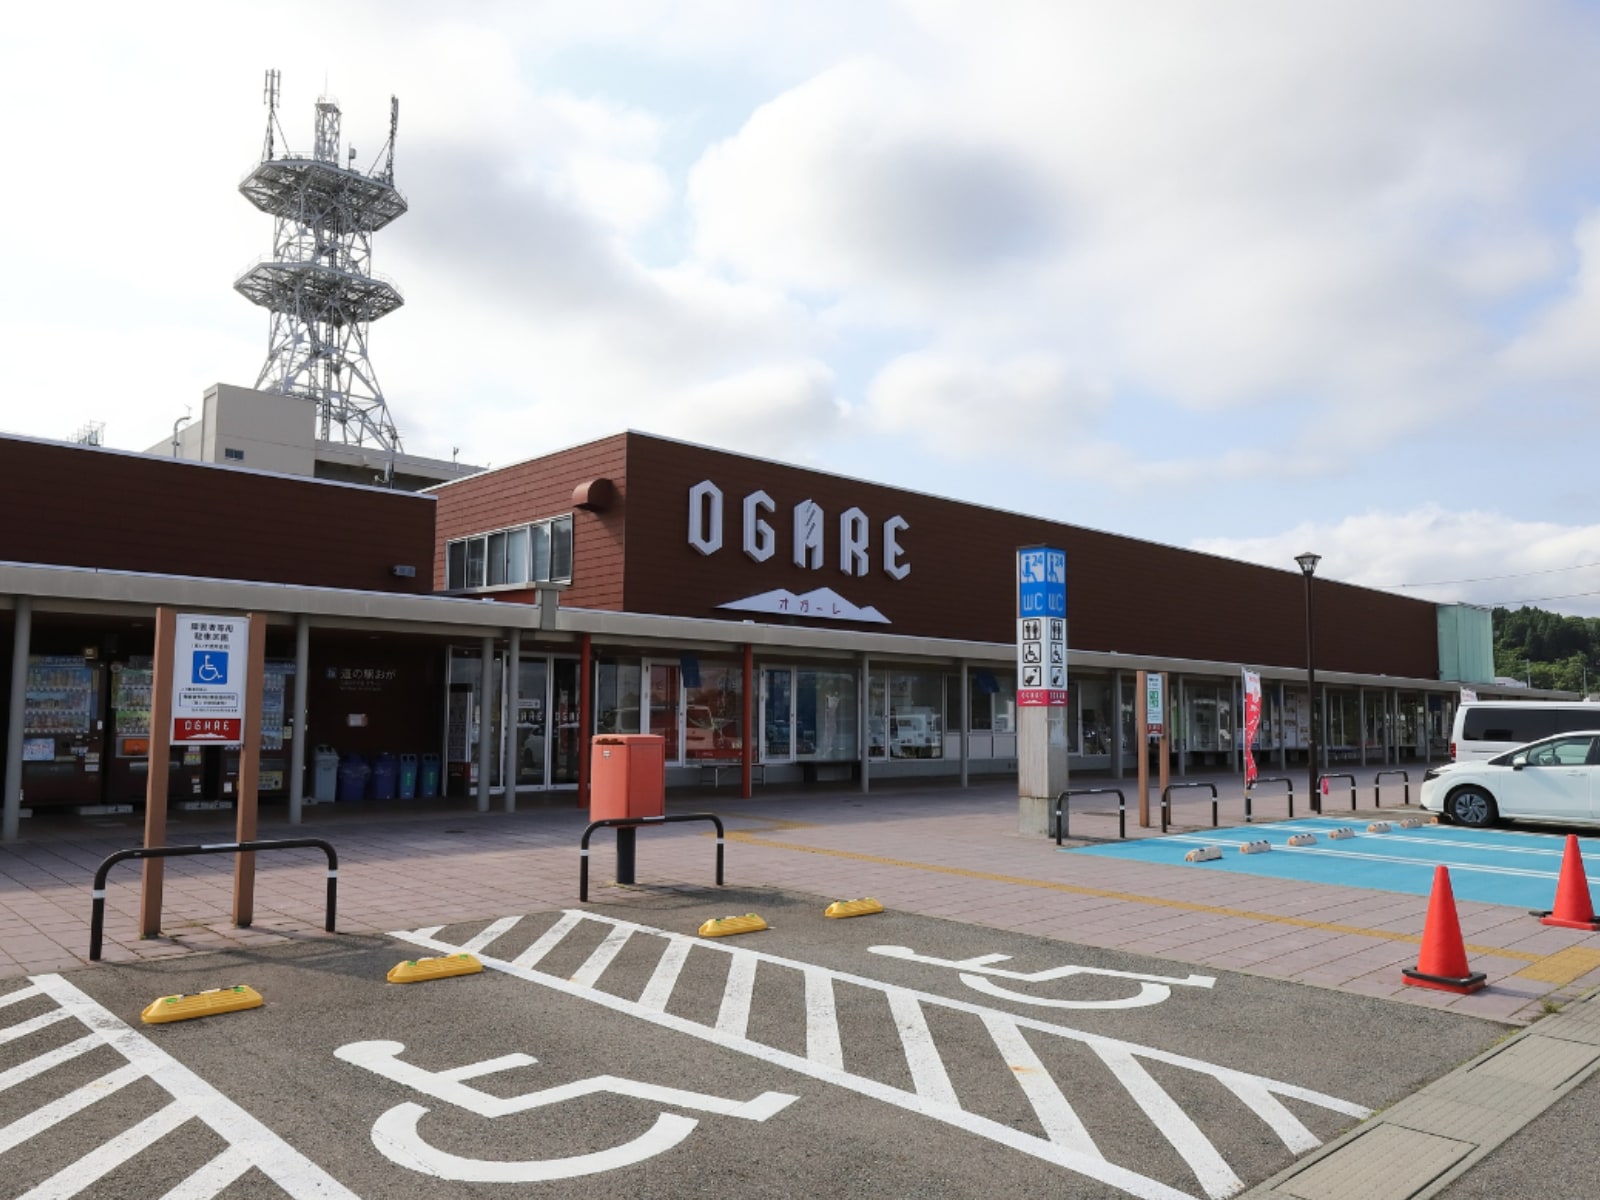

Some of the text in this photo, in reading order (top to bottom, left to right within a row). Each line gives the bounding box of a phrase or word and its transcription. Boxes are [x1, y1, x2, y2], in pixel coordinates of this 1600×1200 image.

[687, 479, 911, 581] OGARE
[1031, 554, 1043, 567] 24
[1054, 554, 1064, 567] 24
[778, 597, 841, 615] オガーレ
[1023, 592, 1044, 611] WC
[1048, 593, 1064, 612] WC
[184, 719, 230, 731] OGARE
